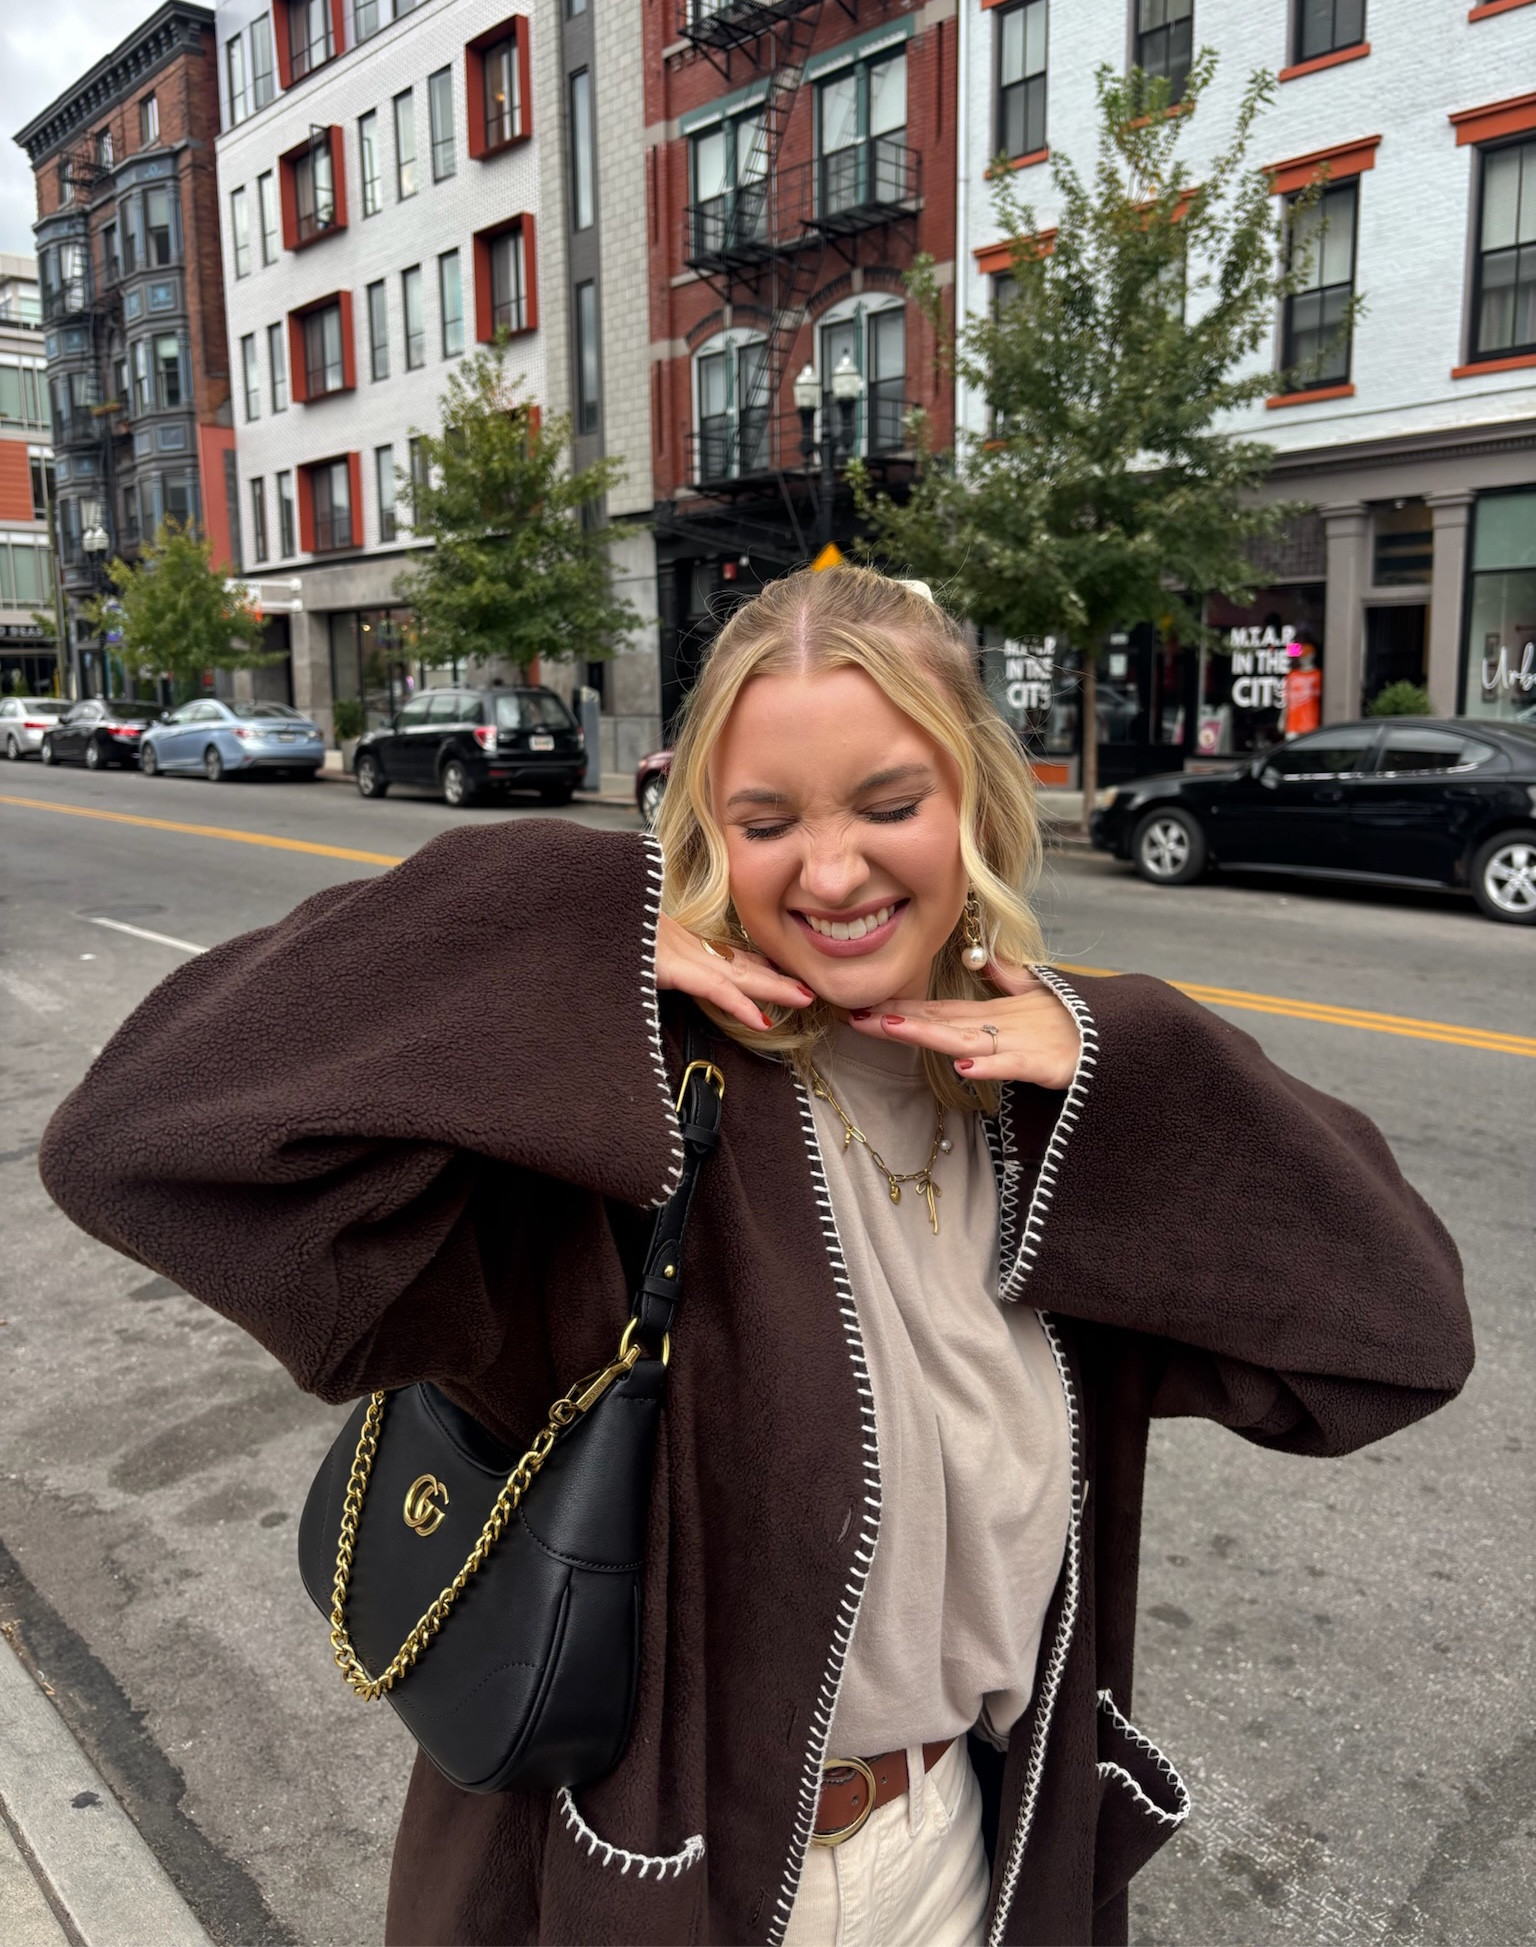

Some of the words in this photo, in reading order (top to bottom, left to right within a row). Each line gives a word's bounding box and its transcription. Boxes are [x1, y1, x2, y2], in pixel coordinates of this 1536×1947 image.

[1231, 650, 1253, 675] IN
[1255, 649, 1291, 675] THE
[1482, 642, 1536, 691] Urb
